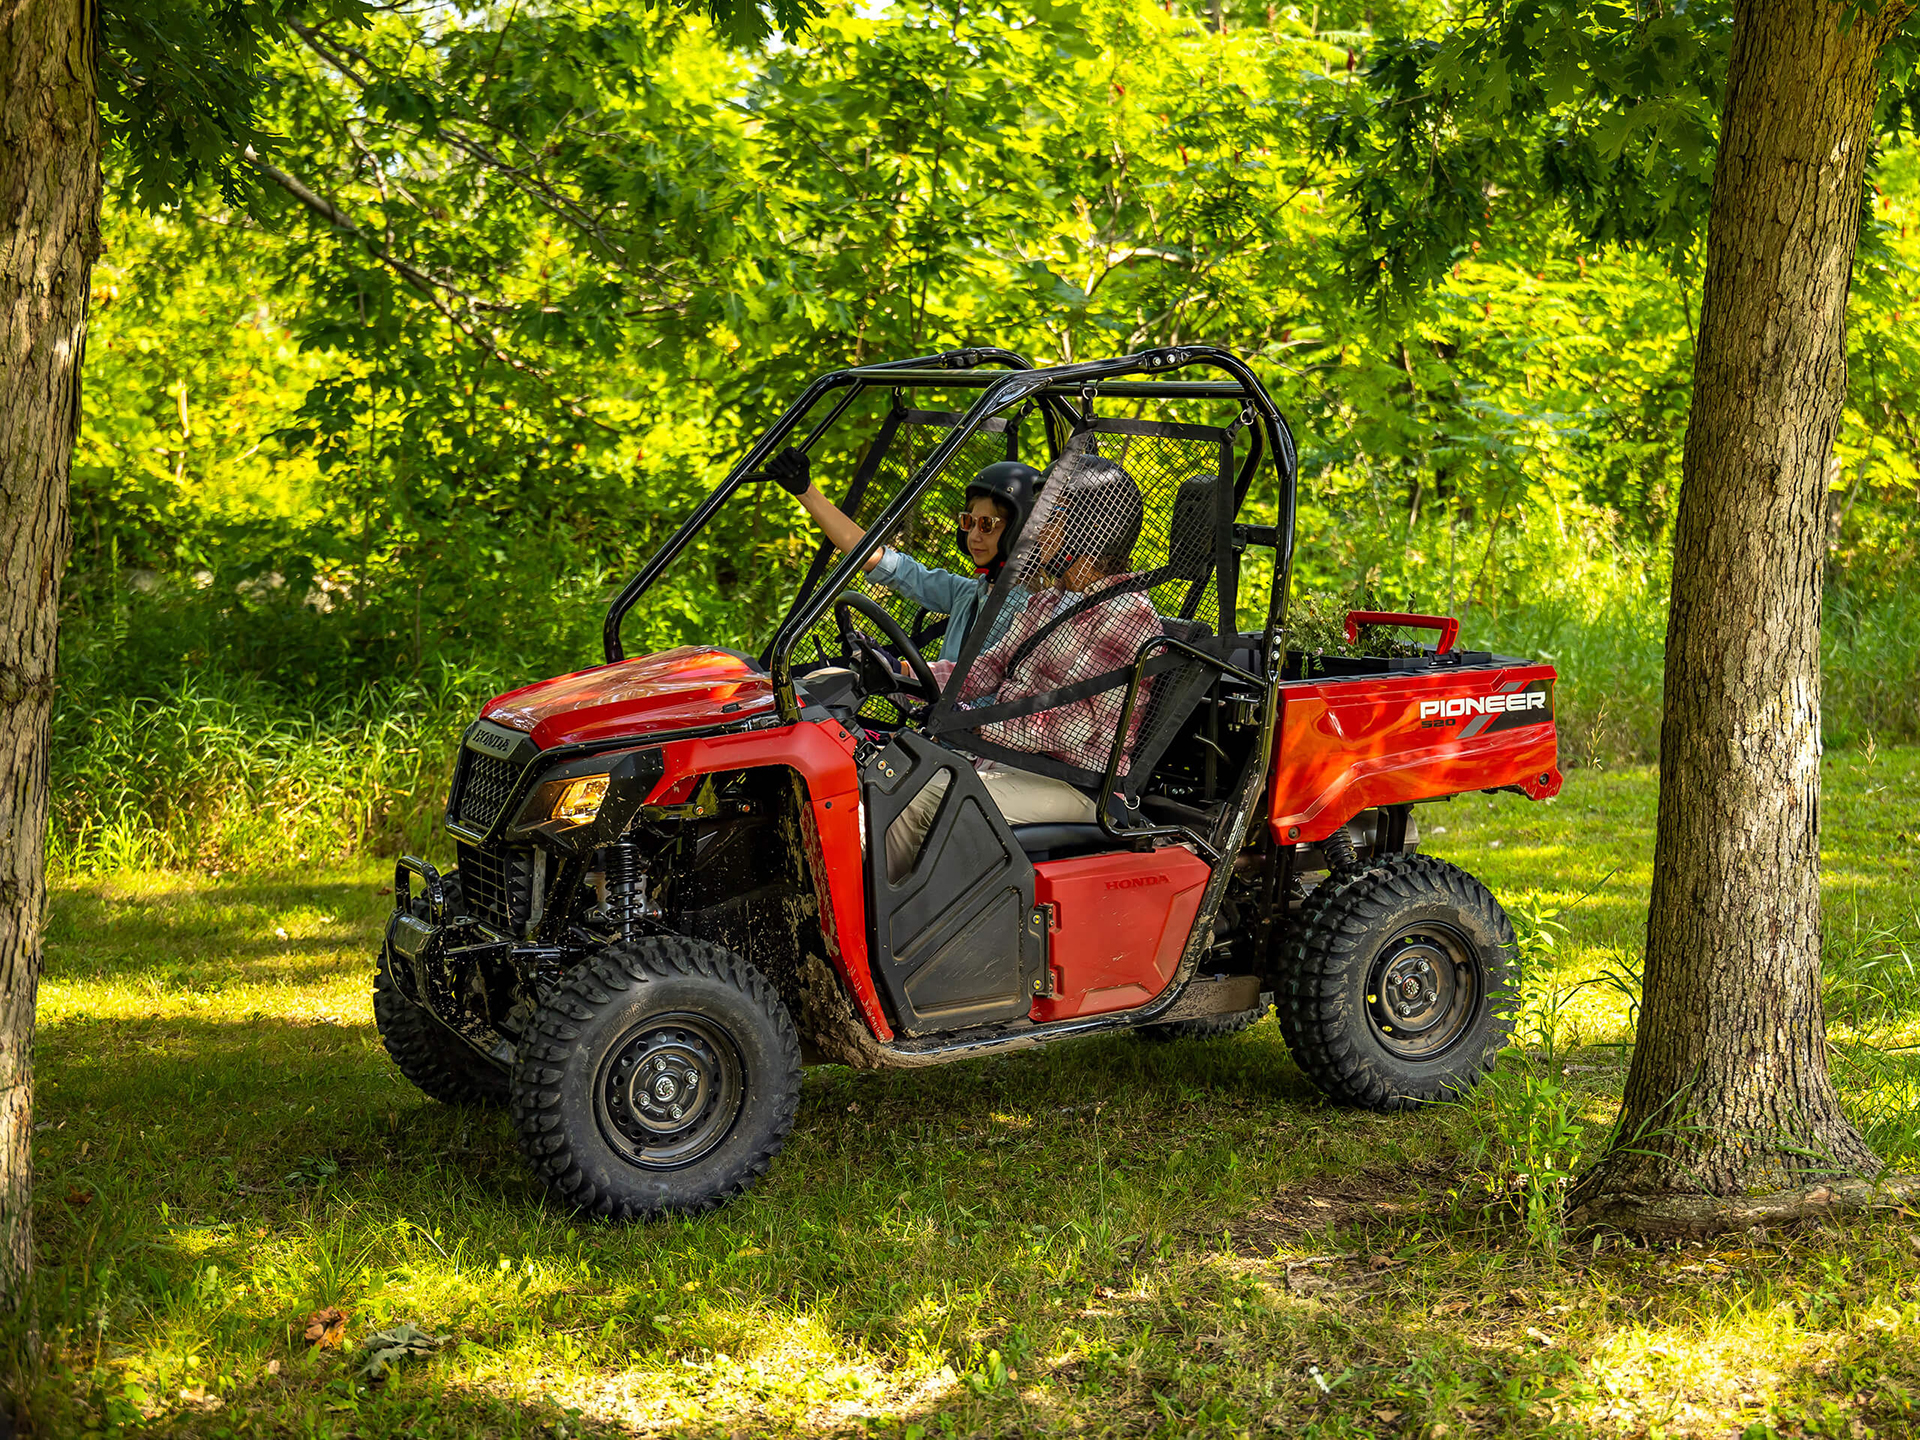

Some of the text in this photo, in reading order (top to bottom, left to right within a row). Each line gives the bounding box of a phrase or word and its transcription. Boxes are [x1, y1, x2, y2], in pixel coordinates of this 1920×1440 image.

[1420, 691, 1546, 719] PIONEER
[1421, 718, 1456, 729] 520
[472, 729, 511, 752] HONDA
[1104, 873, 1171, 890] HONDA
